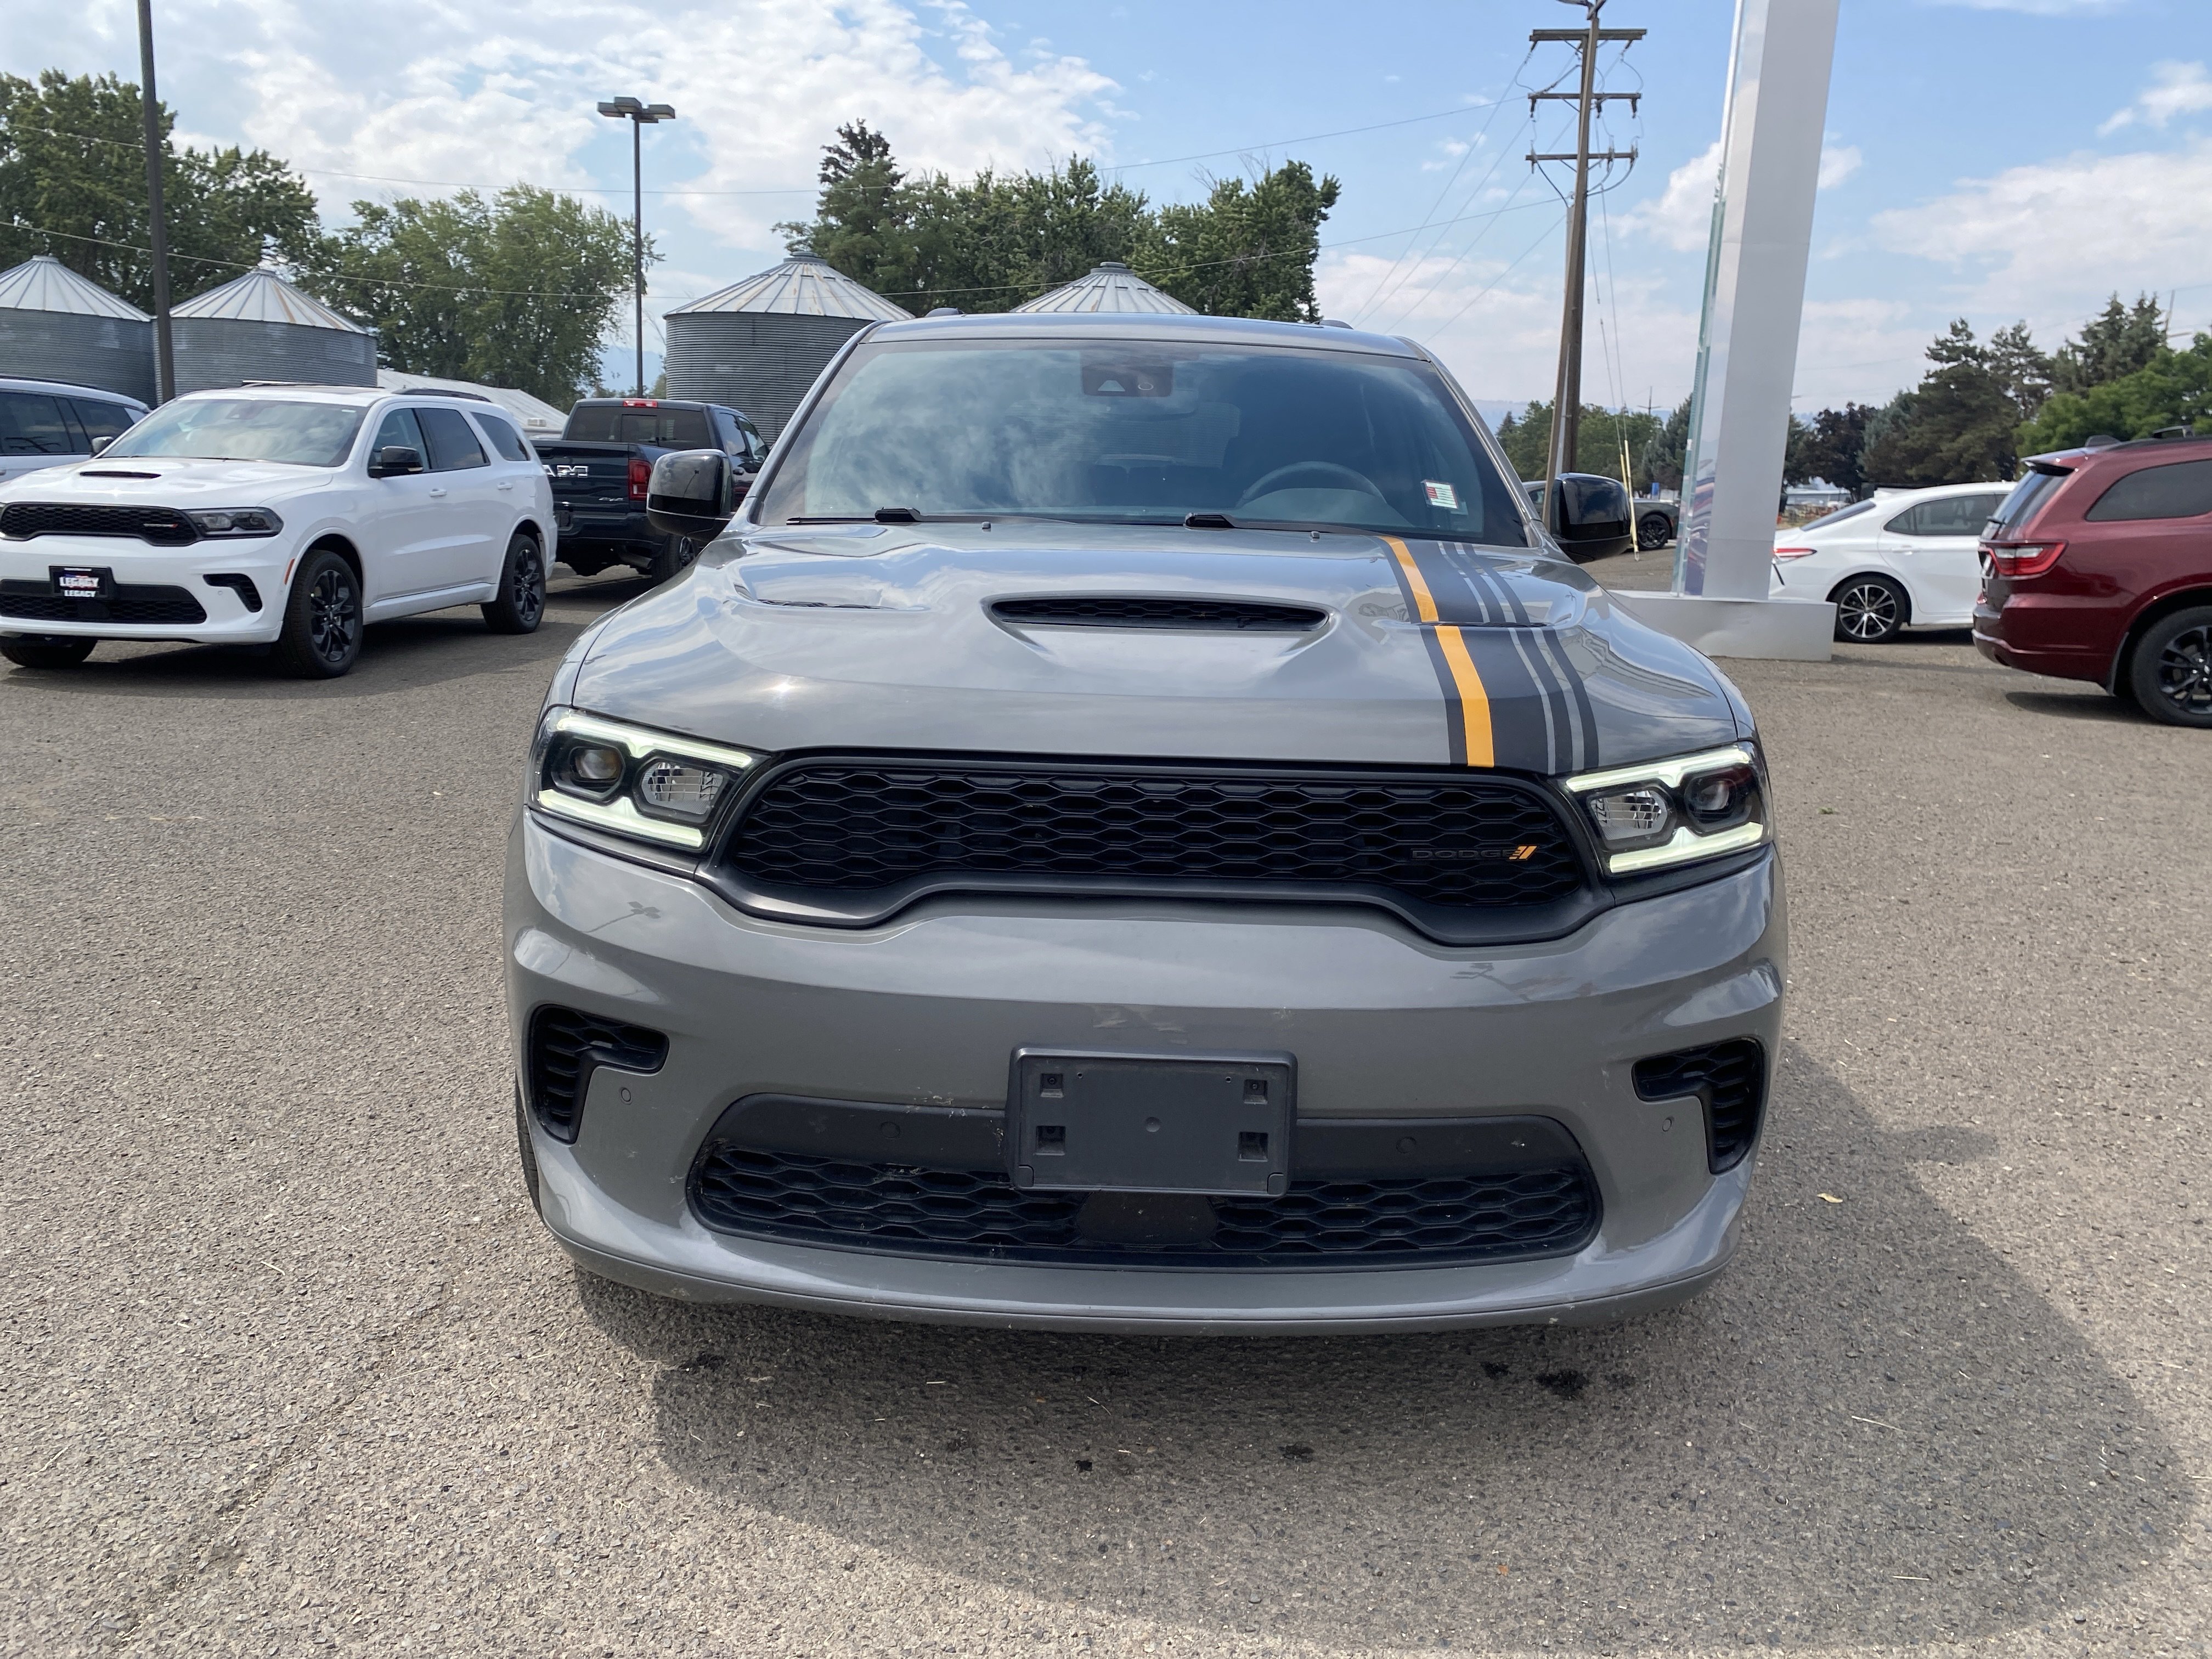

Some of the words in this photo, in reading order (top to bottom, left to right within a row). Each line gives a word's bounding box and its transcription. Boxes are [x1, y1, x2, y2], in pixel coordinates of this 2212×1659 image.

[542, 465, 589, 478] AM
[59, 576, 99, 588] LEGACY
[1412, 849, 1521, 859] DODGE
